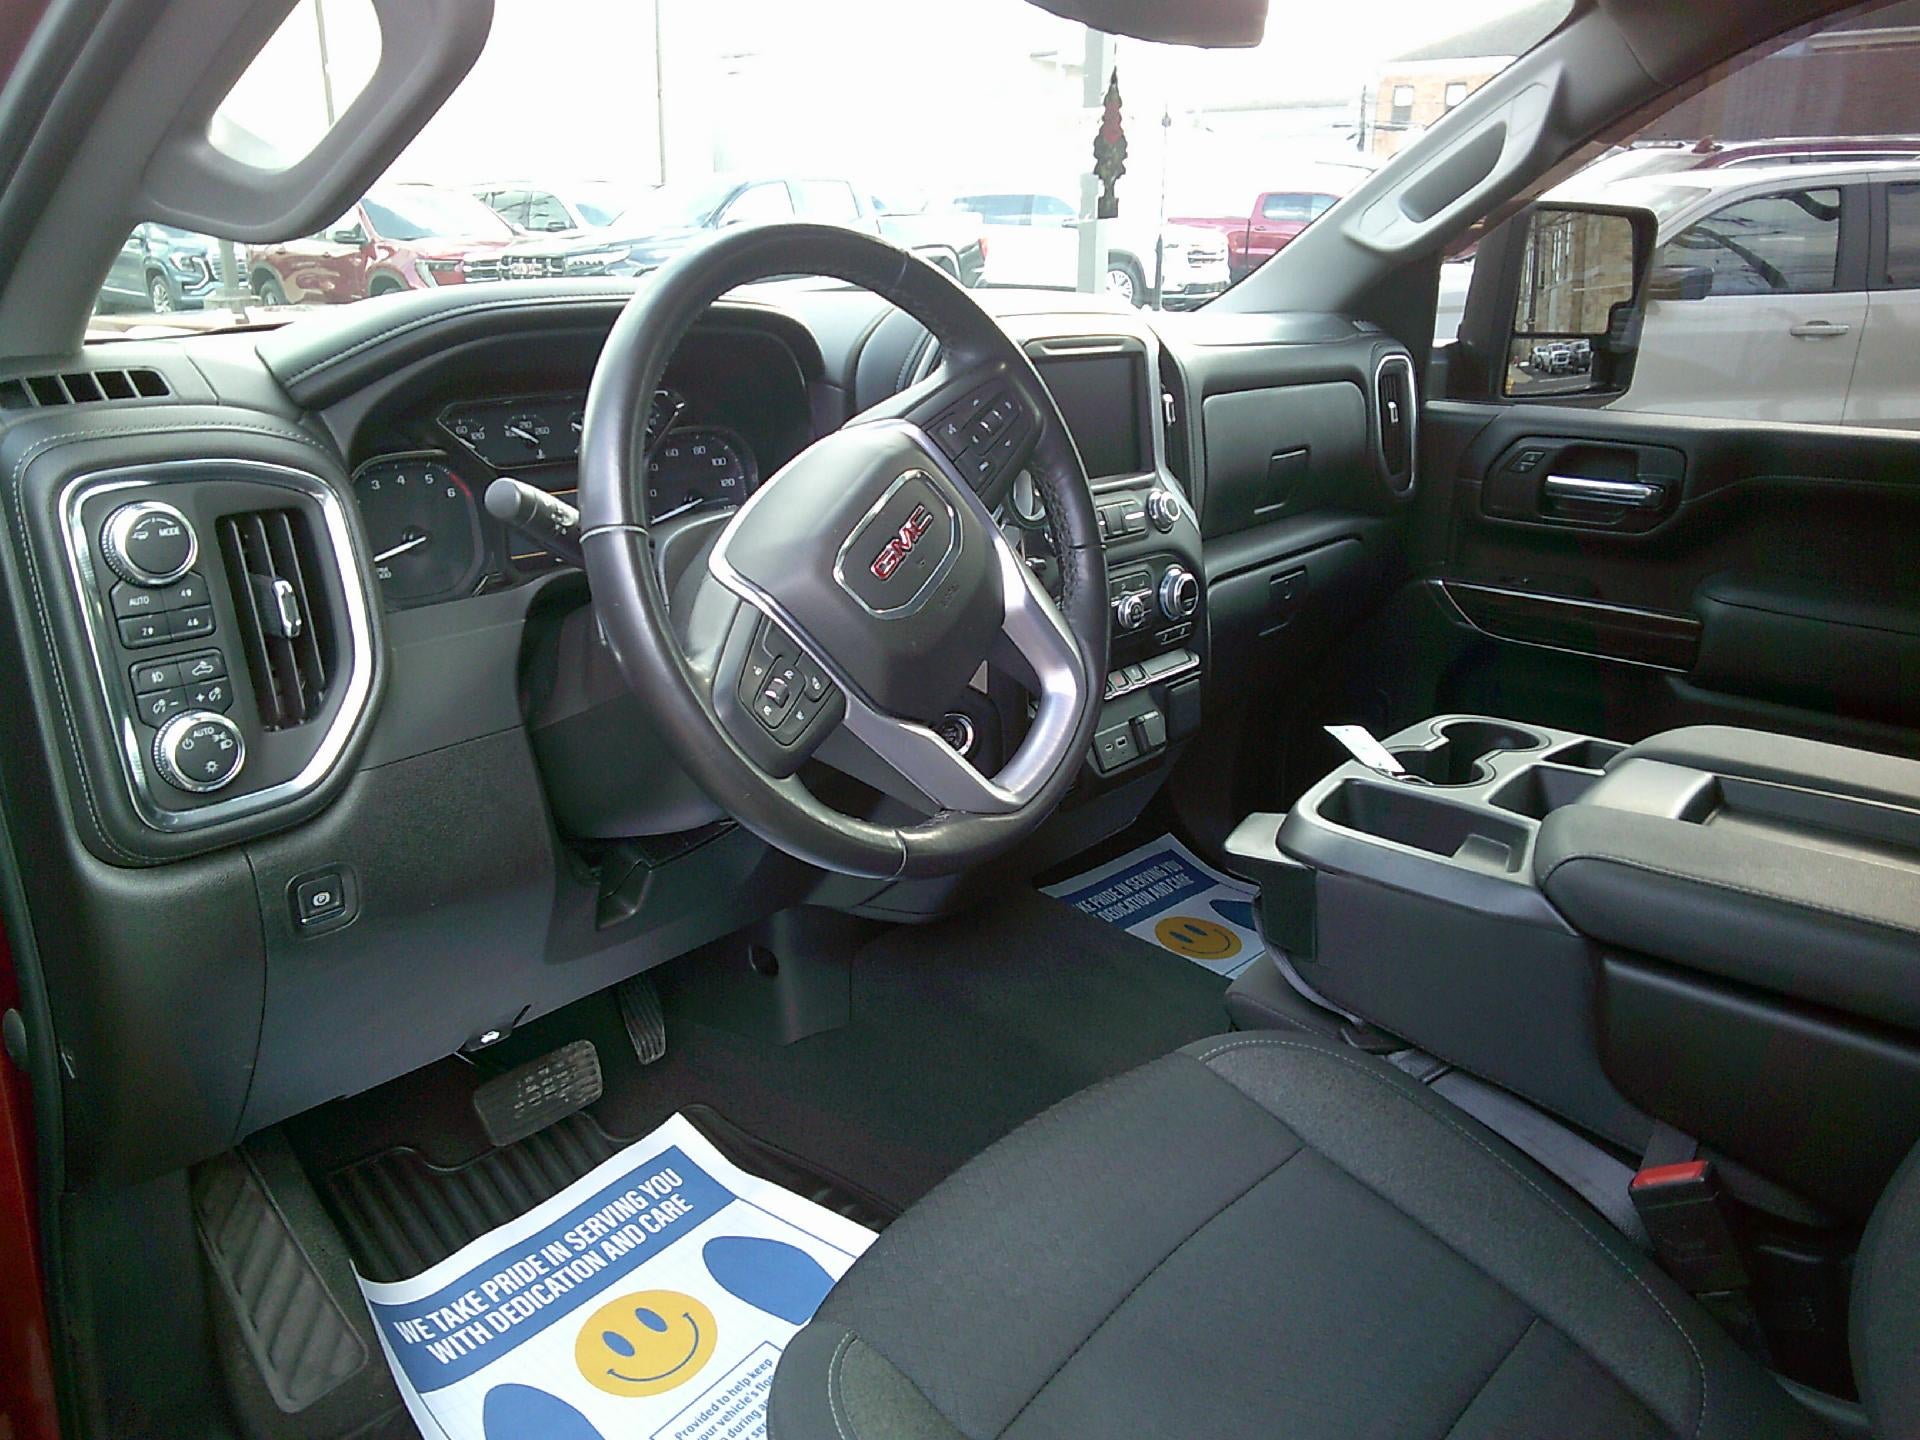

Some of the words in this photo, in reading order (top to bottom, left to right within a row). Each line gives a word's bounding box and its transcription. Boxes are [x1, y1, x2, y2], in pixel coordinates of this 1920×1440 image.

[371, 480, 380, 490] 3
[397, 475, 405, 485] 4
[425, 474, 434, 484] 5
[447, 488, 456, 497] 6
[159, 527, 180, 536] MODE
[871, 504, 934, 578] GMC
[129, 596, 149, 606] AUTO
[194, 727, 214, 738] AUTO
[1088, 888, 1123, 909] PRIDE
[1097, 890, 1157, 922] DEDICATION
[394, 1318, 436, 1344] WE
[425, 1290, 489, 1332] TAKE
[480, 1254, 550, 1302] PRIDE
[541, 1241, 573, 1266] IN
[564, 1191, 649, 1251] SERVING
[638, 1168, 683, 1200] YOU
[426, 1321, 494, 1364] WITH
[485, 1250, 608, 1333] DEDICATION
[601, 1224, 646, 1261] AND
[638, 1193, 694, 1233] CARE
[675, 1403, 720, 1440] Provided
[717, 1395, 730, 1405] to
[727, 1378, 751, 1396] help
[747, 1358, 773, 1379] keep
[697, 1425, 719, 1440] our
[716, 1390, 759, 1426] vehicle's
[728, 1409, 762, 1438] during
